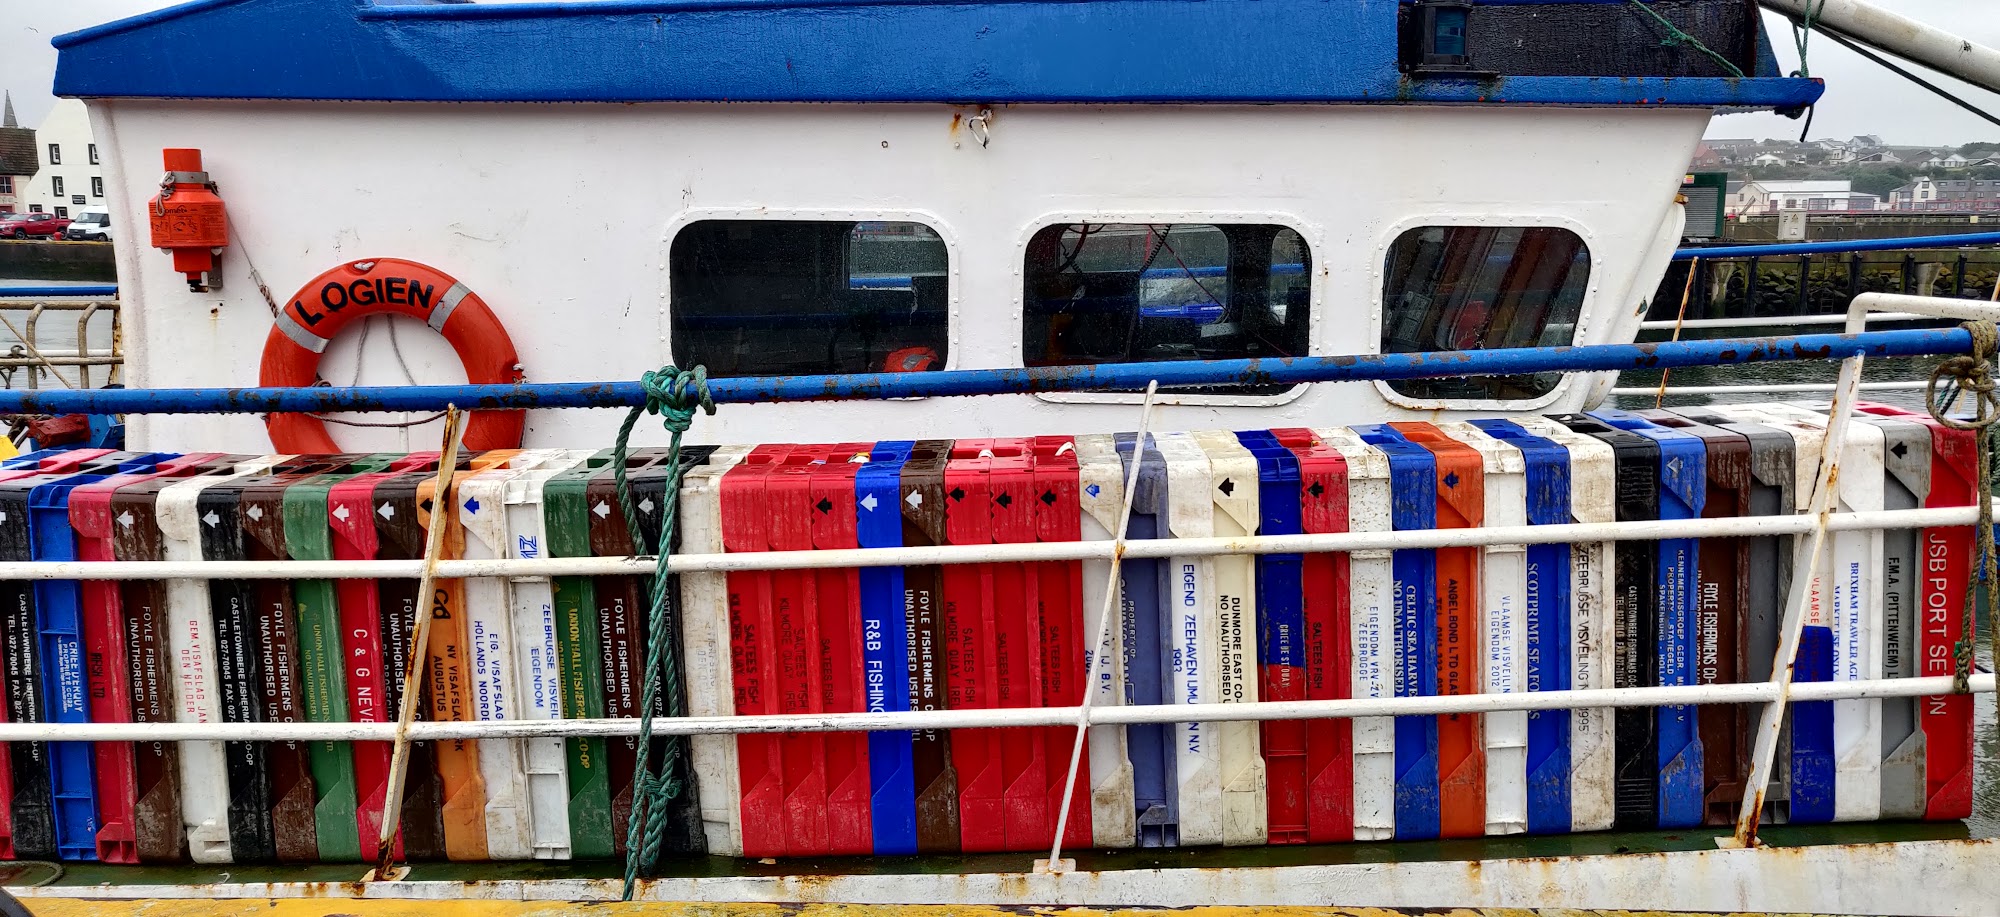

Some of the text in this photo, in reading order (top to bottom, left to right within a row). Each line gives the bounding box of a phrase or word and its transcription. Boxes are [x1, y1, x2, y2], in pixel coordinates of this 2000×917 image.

[294, 277, 434, 327] LOGIEN
[1577, 547, 1590, 617] ZEEBRUGSE
[1887, 557, 1900, 588] F.M.A.
[1928, 533, 1947, 572] JSB
[402, 598, 414, 632] FOYLE
[779, 597, 793, 645] KILMORE
[1128, 600, 1136, 646] PROPERTY
[1220, 595, 1230, 610] NO
[1527, 562, 1540, 645] SCOTPRIME
[1667, 567, 1675, 611] PROPERTY
[1676, 549, 1685, 640] KENNEMERVISGROEP
[1810, 577, 1820, 624] VLAAMSE
[1849, 562, 1859, 682] BRIXHAM TRAWLER AGE
[1928, 578, 1947, 637] PORT
[143, 606, 154, 642] FOYLE
[230, 597, 246, 680] CASTLETOWNBERE
[259, 615, 277, 697] UNAUTHORISED
[273, 602, 293, 712] FOYLE FISHERMENS
[304, 649, 313, 661] NO
[312, 624, 322, 652] UNION
[388, 612, 405, 693] UNAUTHORISED
[446, 645, 457, 660] NV
[567, 608, 580, 642] UNION
[570, 643, 583, 670] HALL
[600, 607, 617, 693] UNAUTHORISED
[613, 598, 632, 709] FOYLE FISHERMENS
[865, 619, 882, 651] R&B
[904, 589, 918, 672] UNAUTHORISED
[919, 590, 934, 698] FOYLE FISHERMENS
[946, 601, 961, 710] KILMORE QUAY IREL
[1184, 614, 1198, 676] ZEEHAVEN
[1220, 613, 1231, 696] UNAUTHORISED
[1231, 597, 1244, 703] DUNMORE EAST CO-
[1312, 621, 1323, 688] SALTEES FISH
[1369, 606, 1379, 657] EIGENDOM
[1393, 580, 1405, 694] NO UNAUTHORISED
[1406, 585, 1418, 697] CELTIC SEA HARVE
[1447, 578, 1459, 669] ANGELBOND LTD
[1491, 610, 1501, 688] EIGENDOM 2012
[1501, 595, 1512, 694] VLAAMSE VISVEILIN
[1577, 621, 1590, 682] VISVEILING
[1667, 624, 1675, 675] STATIEGELD
[1703, 582, 1719, 685] FOYLE FISHERMENS CO-
[1886, 591, 1900, 668] (PITTENWEEM)
[8, 614, 23, 724] TEL: 027-70045 FAX: 027-7
[129, 617, 145, 702] UNAUTHORISED
[146, 647, 160, 716] FISHERMENS
[181, 649, 191, 669] DEN
[191, 644, 205, 701] VISAFSLAG
[218, 618, 234, 704] TEL: 027-70045 FAX:
[305, 662, 318, 715] UNAUTHORISED
[316, 653, 326, 673] HALL
[353, 628, 374, 723] C & G NEVE
[432, 655, 447, 712] AUGUSTUS
[474, 620, 491, 722] HOLLANDS NOORDE
[489, 633, 505, 720] EIG. VISAFSLAG
[530, 648, 544, 708] EIGENDOM
[542, 603, 560, 720] ZEEBRUGSE VISVEIL
[743, 624, 760, 704] SALTEES FISH
[793, 628, 810, 709] SALTEES FISH
[821, 638, 835, 706] SALTEES FISH
[962, 628, 976, 703] SALTEES FISH
[997, 632, 1010, 700] SALTEES FISH
[1049, 625, 1062, 693] SALTEES FISH
[1101, 673, 1111, 694] B.V.
[1658, 654, 1666, 687] HOLLAN
[1676, 645, 1685, 671] GEBR.
[26, 677, 37, 724] FISHERMAN
[237, 681, 250, 724] FISHERMA
[734, 687, 748, 716] IRELA
[1188, 734, 1200, 755] N.V.
